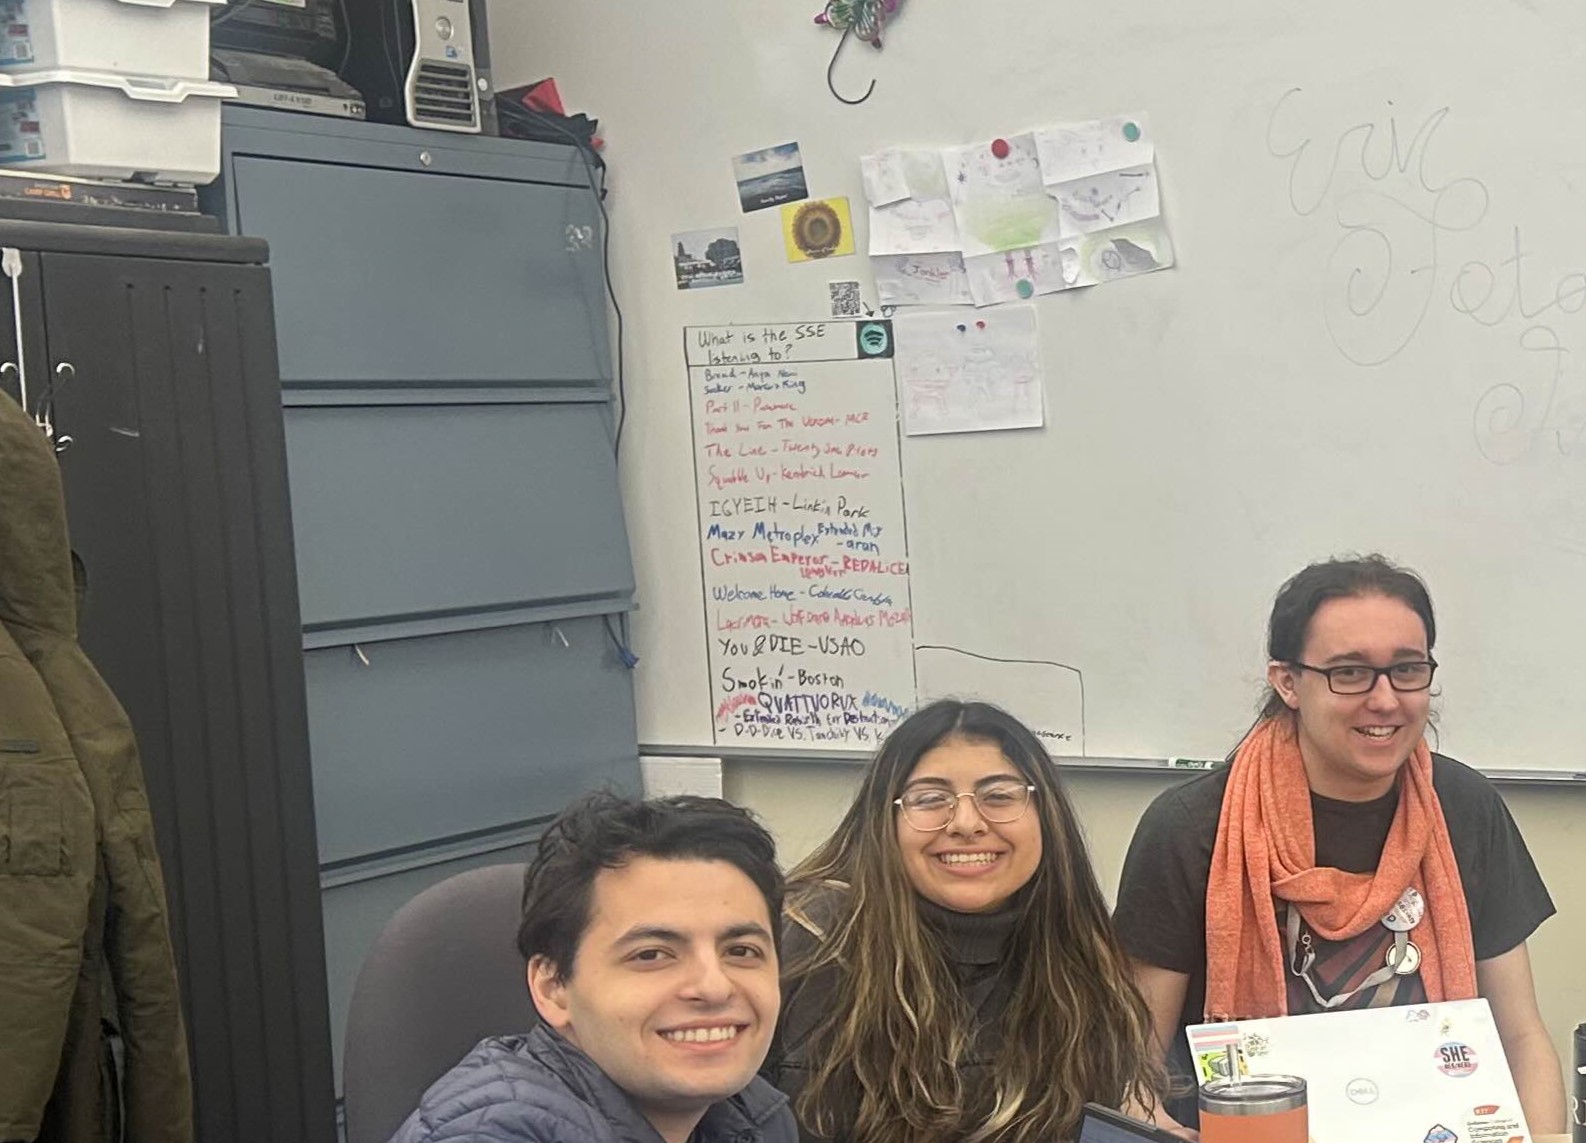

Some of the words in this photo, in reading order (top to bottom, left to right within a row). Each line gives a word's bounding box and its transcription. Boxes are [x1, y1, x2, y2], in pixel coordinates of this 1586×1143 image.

[698, 329, 734, 348] What
[743, 333, 756, 343] is
[762, 328, 787, 343] the
[795, 324, 826, 340] SSE
[768, 343, 793, 360] to?
[782, 380, 807, 395] King
[703, 443, 732, 458] The
[792, 493, 831, 516] Linkin
[837, 494, 871, 519] Park
[752, 521, 820, 547] Metroplex
[712, 582, 768, 602] Welcome
[769, 584, 797, 601] Home
[717, 636, 749, 657] You
[769, 634, 806, 656] DIE
[797, 668, 845, 689] Boston
[1440, 1045, 1471, 1063] SHE
